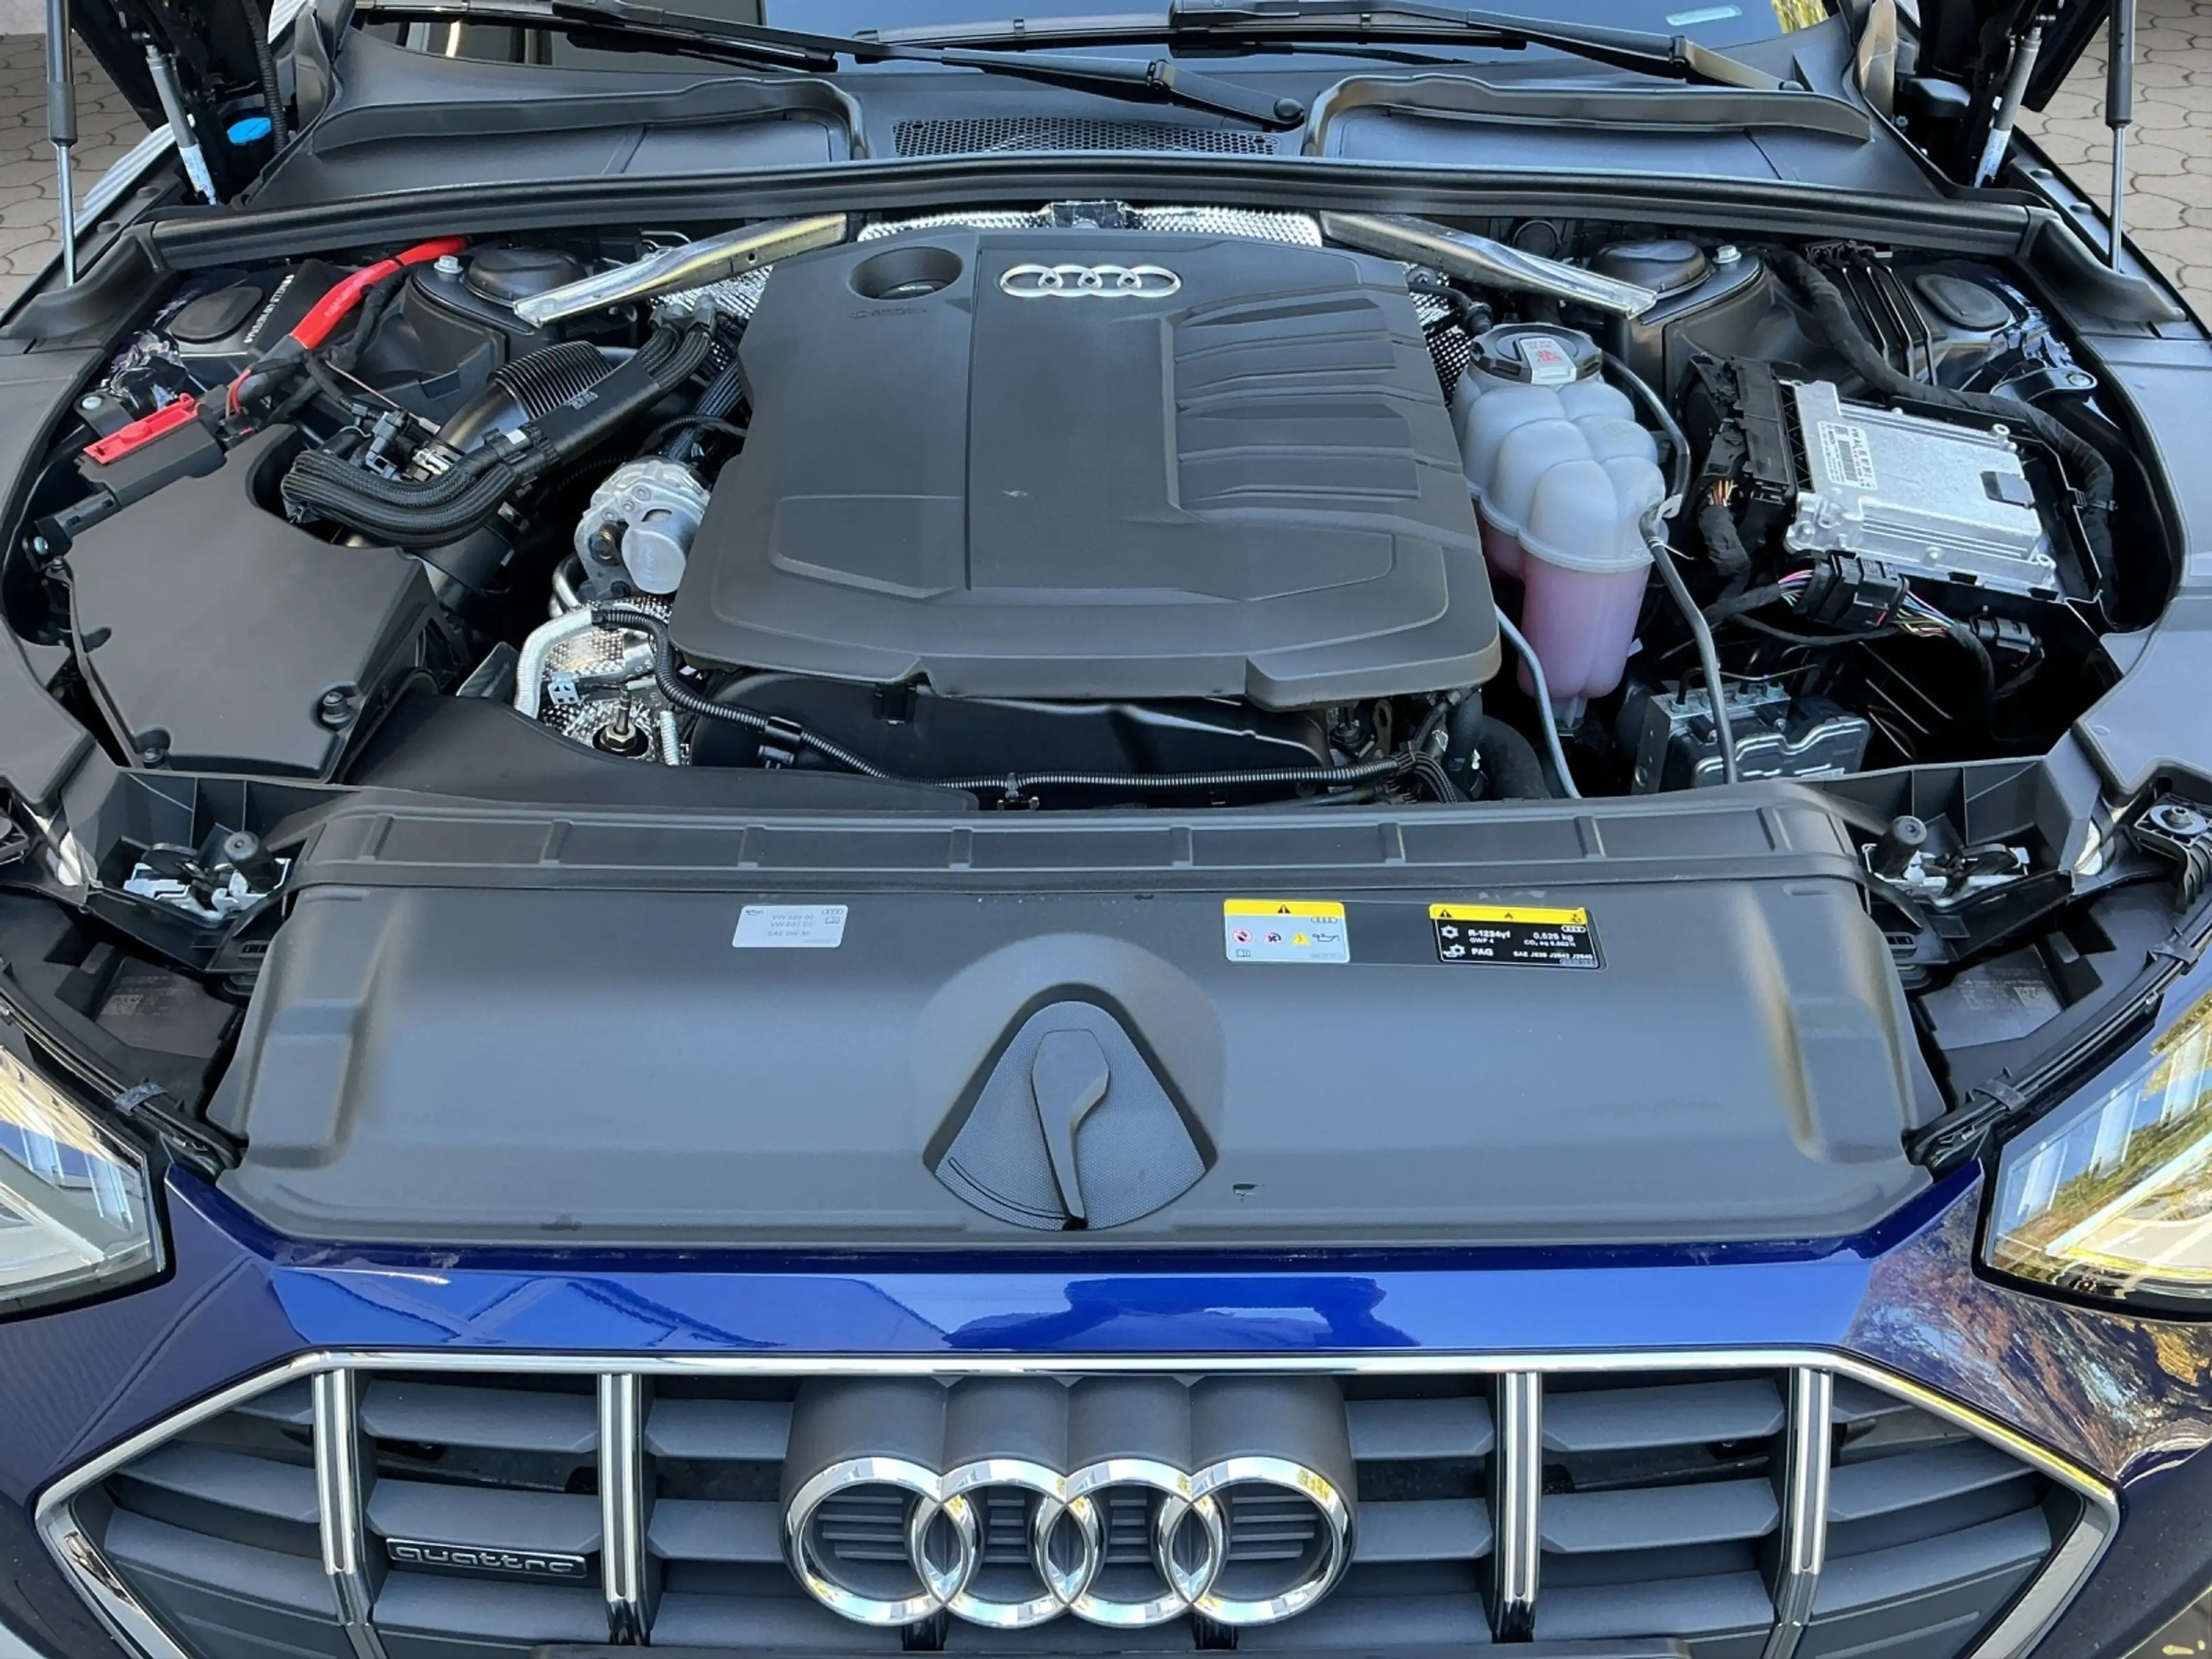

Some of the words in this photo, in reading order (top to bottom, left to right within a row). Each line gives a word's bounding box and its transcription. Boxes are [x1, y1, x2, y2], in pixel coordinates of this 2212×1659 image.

[1468, 929, 1510, 940] R-1234yf
[1561, 933, 1574, 942] kg
[1471, 948, 1494, 956] PAG
[396, 1546, 574, 1573] quattro
